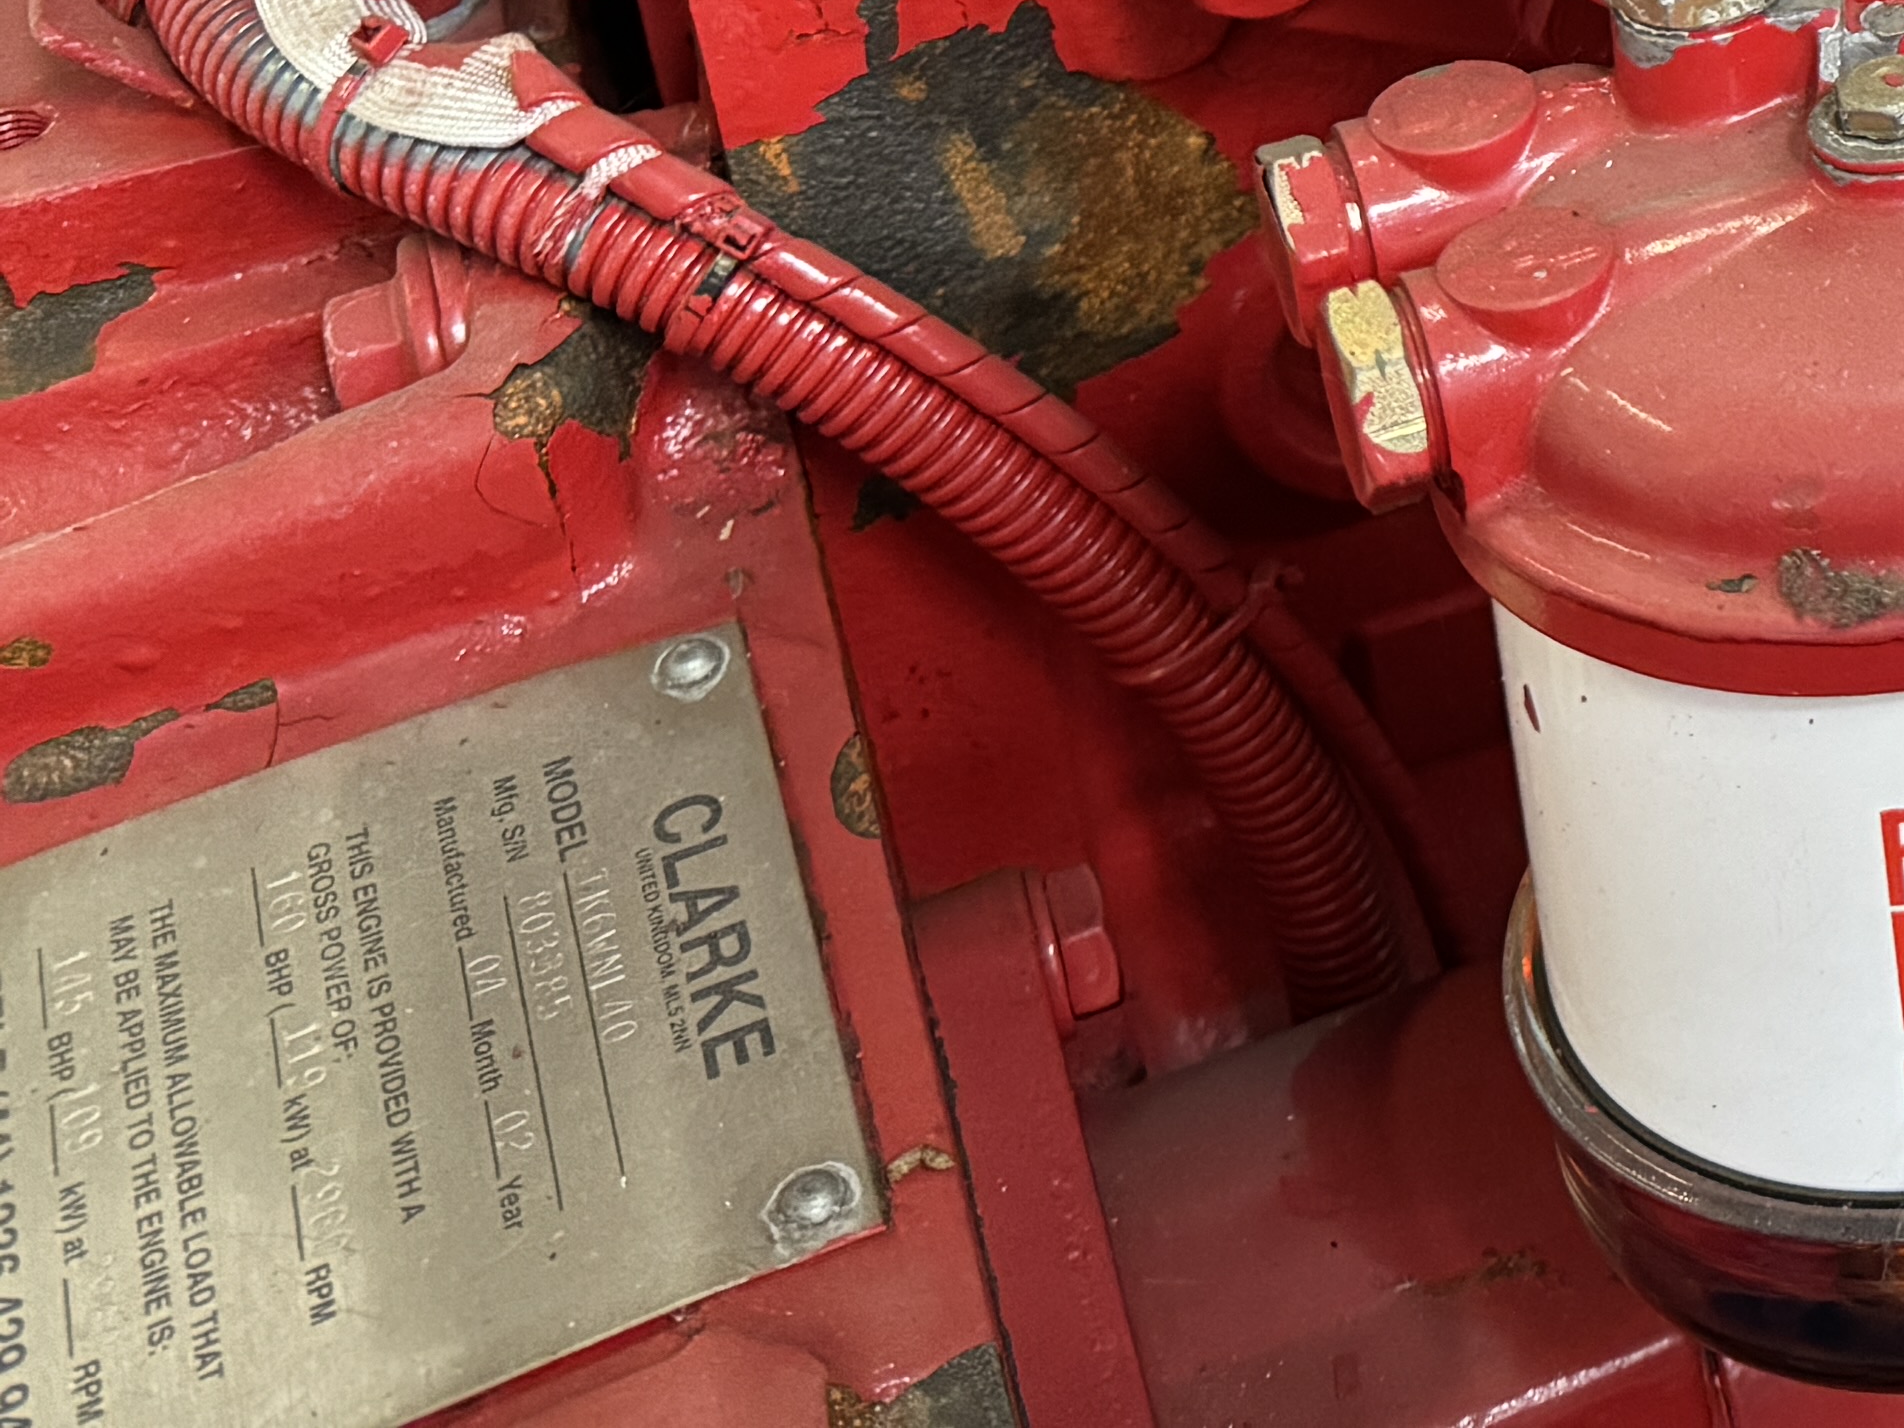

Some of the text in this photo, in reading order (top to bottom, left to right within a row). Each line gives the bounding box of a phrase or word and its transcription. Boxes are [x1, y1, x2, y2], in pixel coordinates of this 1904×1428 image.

[542, 755, 588, 863] MODEL
[501, 822, 530, 863] S/N
[266, 870, 307, 935] 160
[306, 842, 340, 925] GROSS
[109, 914, 139, 963] MAY
[319, 925, 353, 1014] POWER
[634, 847, 660, 903] UNITED
[669, 1017, 692, 1054] 2NN
[653, 794, 776, 1080] CLARKE
[112, 968, 142, 1005] BE
[264, 948, 294, 997] BHP
[345, 826, 426, 1226] THIS ENGINE IS PROVIDED WITH A
[432, 795, 477, 942] Manufactured
[469, 1017, 504, 1095] Month
[497, 1174, 524, 1231] Year
[46, 1030, 76, 1082] BHP
[115, 1008, 150, 1110] APPLIED
[126, 1111, 156, 1151] TO
[149, 898, 226, 1381] THE MAXIMUM ALLOWABLE LOAD THAT
[280, 1093, 312, 1144] kW)
[131, 1151, 162, 1210] THE
[290, 1147, 315, 1172] at
[54, 1180, 89, 1235] kW)
[62, 1237, 89, 1267] at
[135, 1210, 173, 1317] ENGINE
[304, 1262, 337, 1327] RPM
[72, 1358, 105, 1427] RPM
